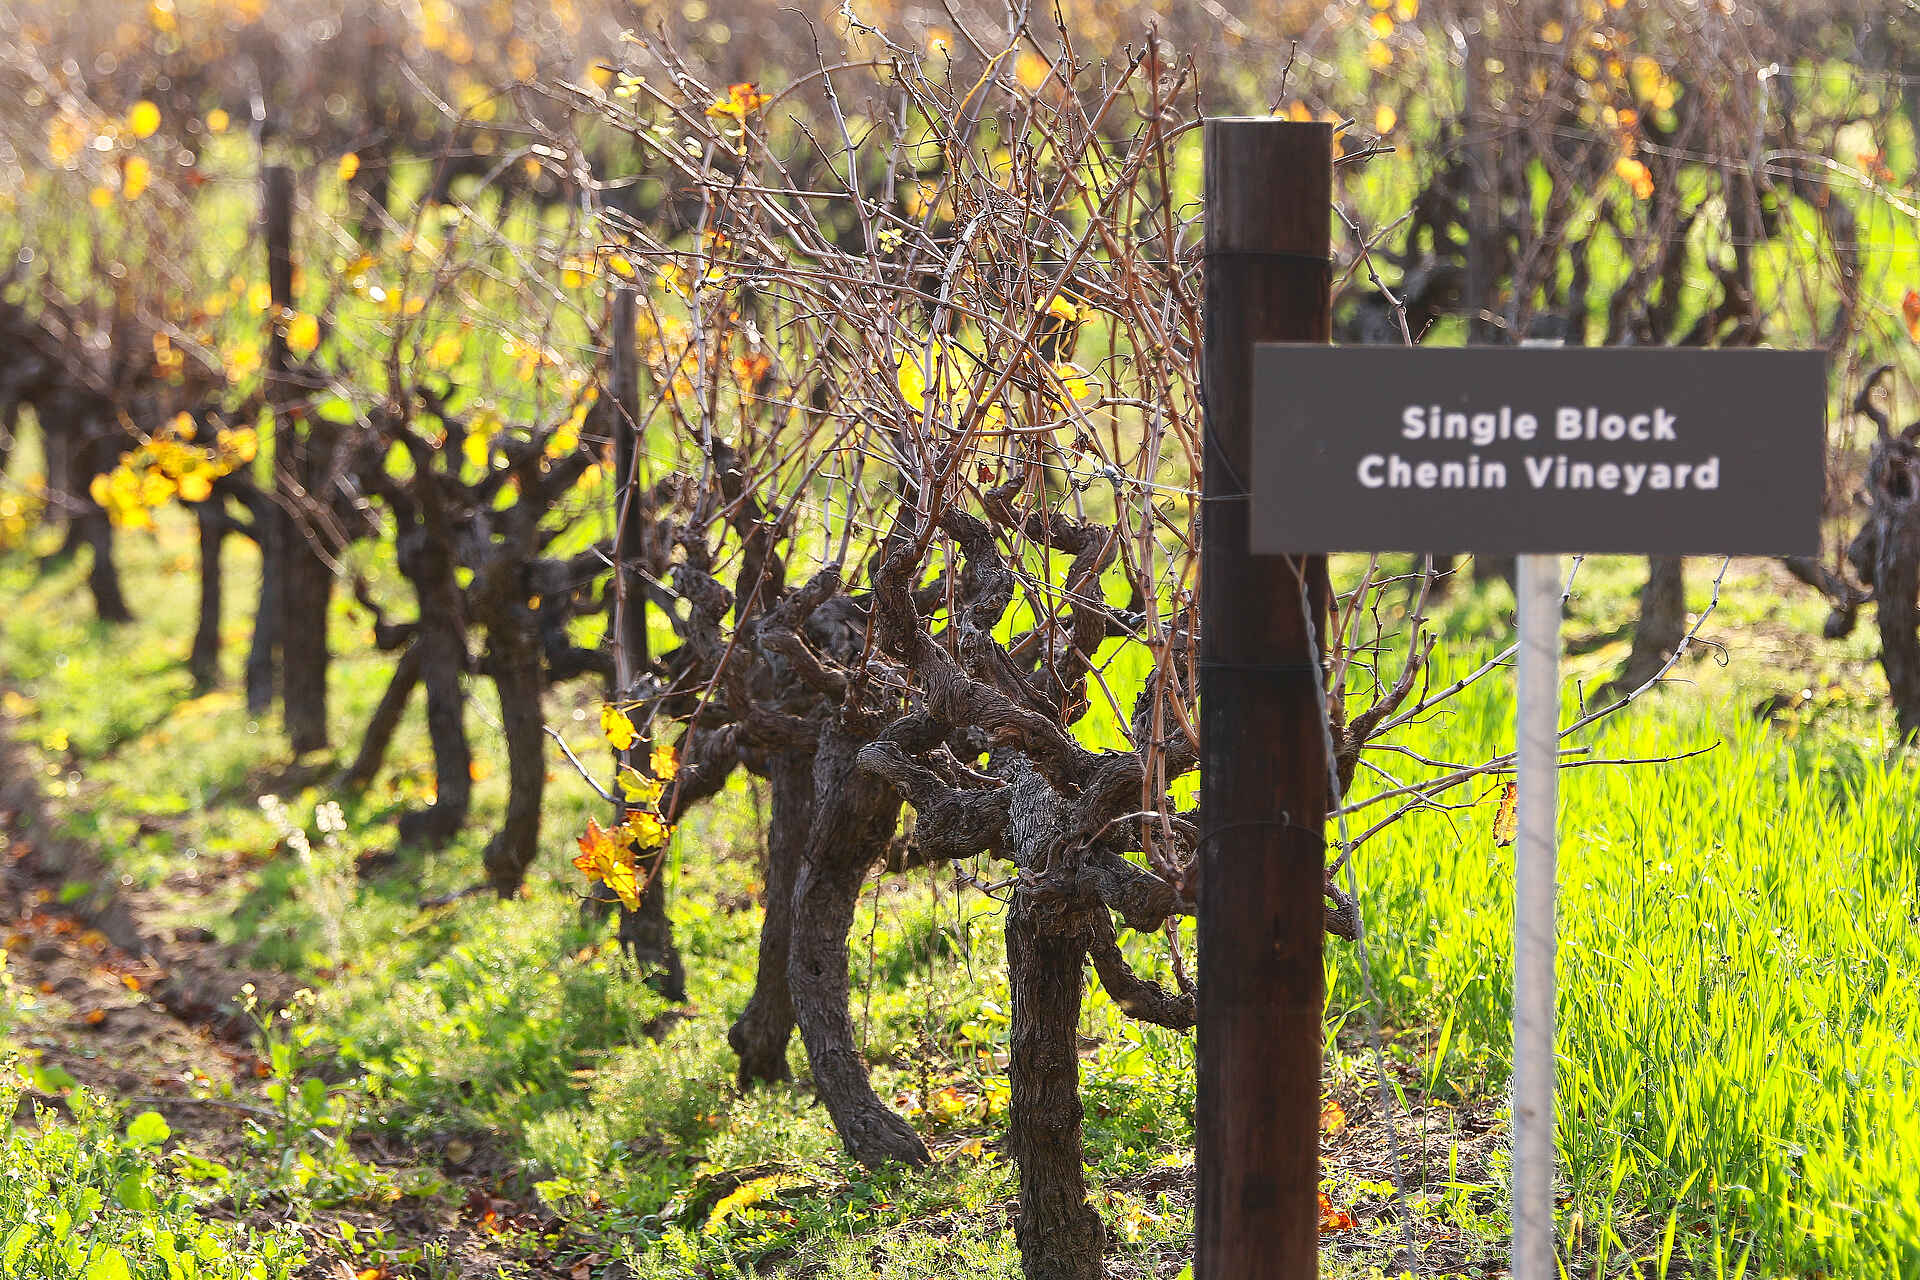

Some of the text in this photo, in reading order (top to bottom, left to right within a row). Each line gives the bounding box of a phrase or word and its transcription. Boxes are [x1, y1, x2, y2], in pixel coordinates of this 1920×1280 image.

[1402, 406, 1677, 445] Single Block
[1357, 454, 1721, 495] Chenin Vineyard
